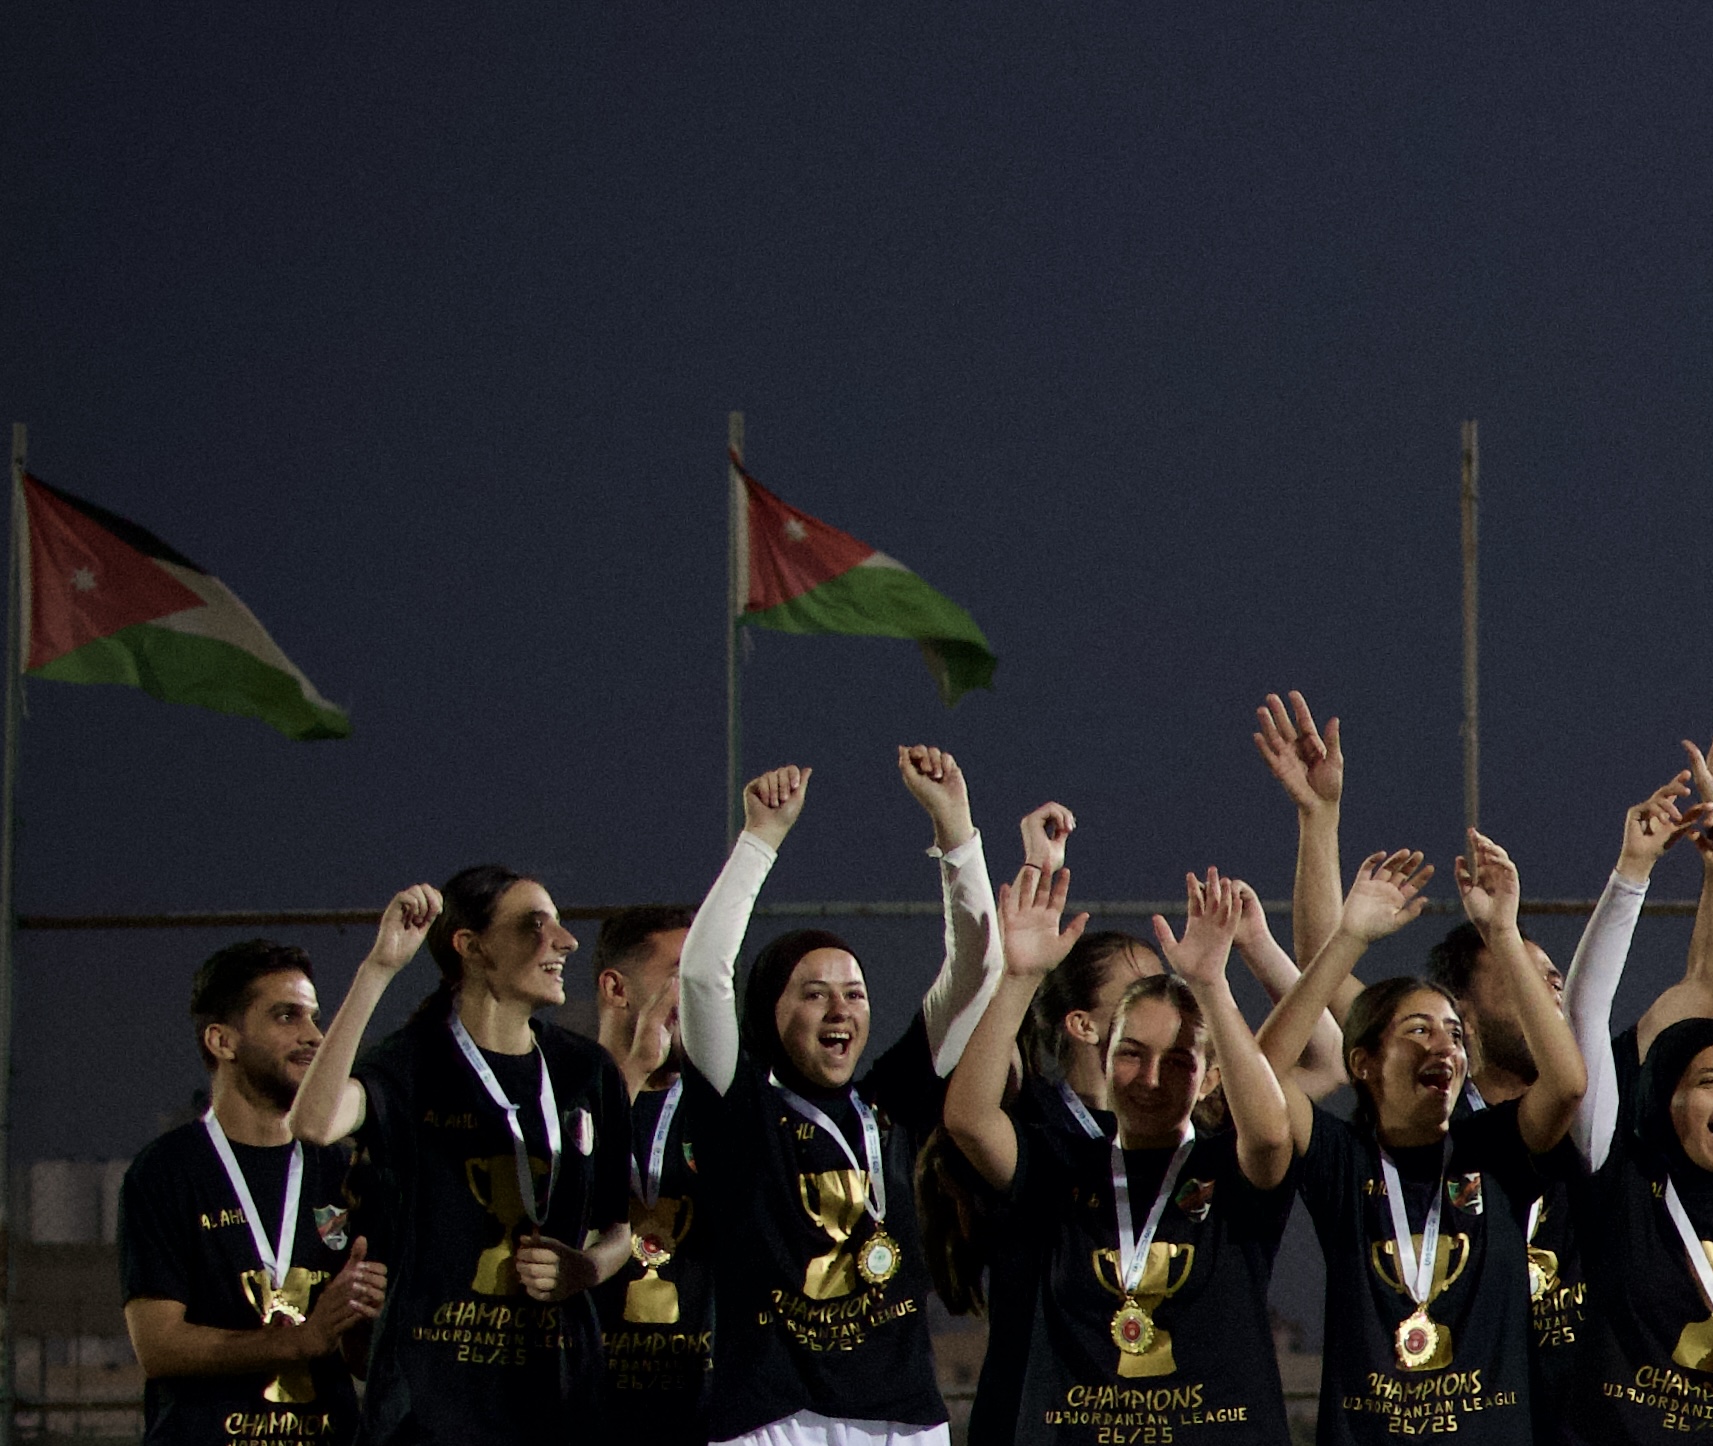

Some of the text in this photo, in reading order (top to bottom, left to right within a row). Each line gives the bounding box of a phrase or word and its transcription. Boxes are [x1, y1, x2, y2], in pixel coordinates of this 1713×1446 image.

[220, 1207, 248, 1228] AHL
[1066, 1383, 1205, 1412] CHAMPIONS
[224, 1409, 334, 1437] CHAMPION
[1180, 1406, 1248, 1425] LEAGUE
[1388, 1415, 1459, 1435] 26/25
[1097, 1426, 1174, 1445] 26/25
